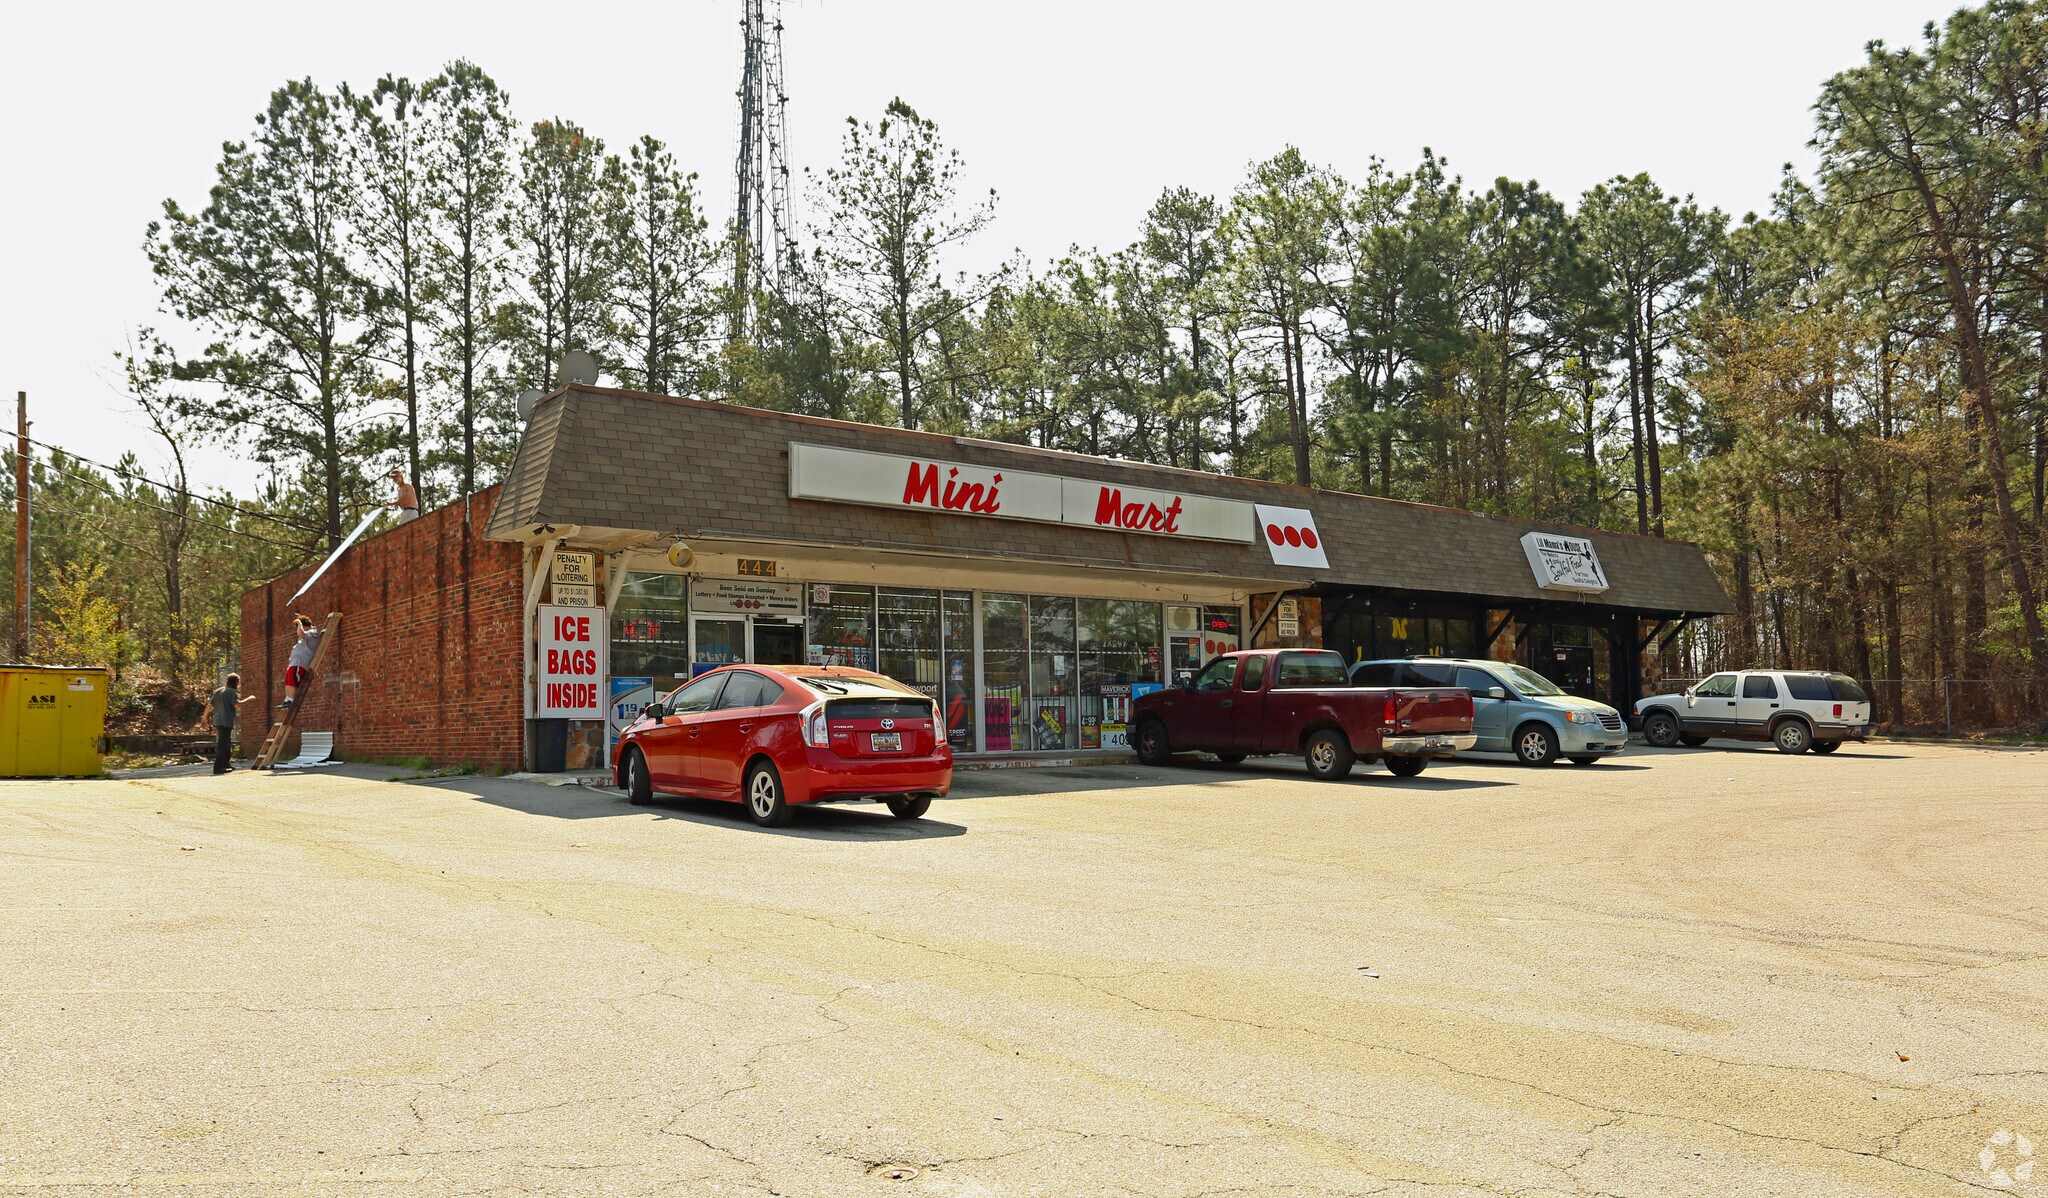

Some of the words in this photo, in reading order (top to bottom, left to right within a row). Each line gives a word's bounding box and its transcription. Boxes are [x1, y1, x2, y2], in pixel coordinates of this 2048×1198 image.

[902, 461, 1003, 514] Mini
[1094, 486, 1183, 533] Mart
[1543, 539, 1564, 550] Mama's
[557, 554, 588, 564] PENALTY
[564, 564, 580, 573] FOR
[739, 559, 775, 576] 444
[557, 573, 589, 582] LOITERING
[755, 586, 776, 594] Sunday
[558, 597, 568, 605] AND
[569, 598, 588, 606] PRISON
[554, 616, 590, 641] ICE
[1211, 620, 1228, 628] OPEN
[547, 649, 597, 675] BAGS
[1101, 685, 1130, 693] MAVERICK
[29, 695, 56, 703] ASI
[546, 683, 597, 708] INSIDE
